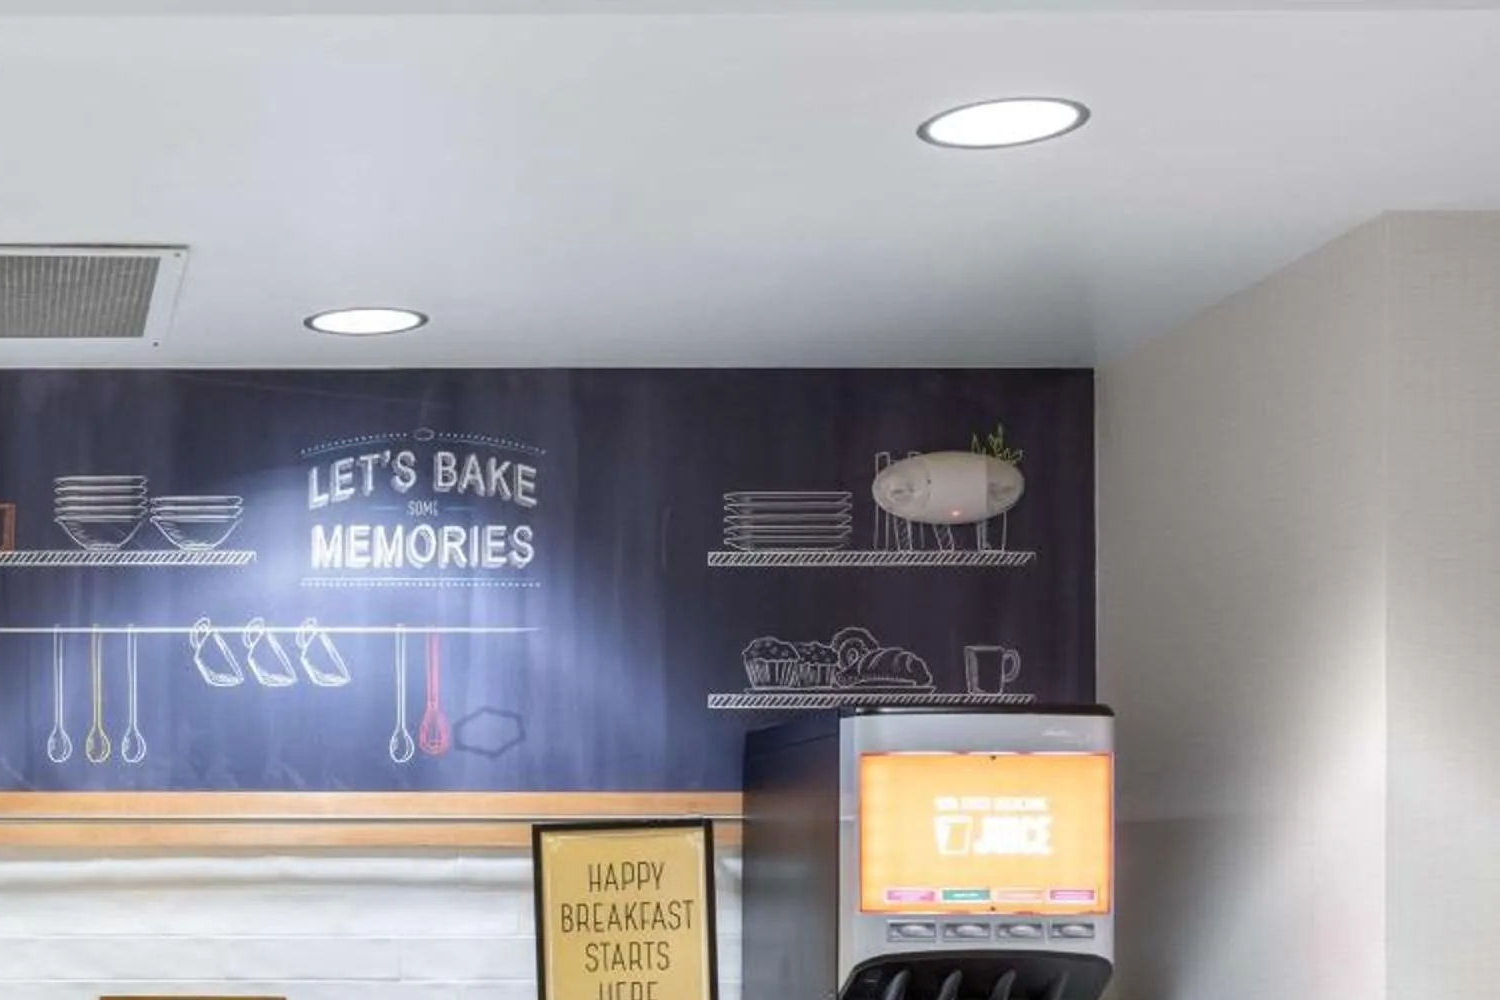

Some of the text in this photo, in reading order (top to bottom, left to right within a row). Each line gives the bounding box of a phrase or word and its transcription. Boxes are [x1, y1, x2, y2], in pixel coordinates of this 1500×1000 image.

[308, 450, 538, 511] LET'S BAKE
[311, 524, 535, 569] MEMORIES
[588, 861, 666, 893] HAPPY
[561, 900, 694, 933] BREAKFAST
[585, 941, 670, 973] STARTS
